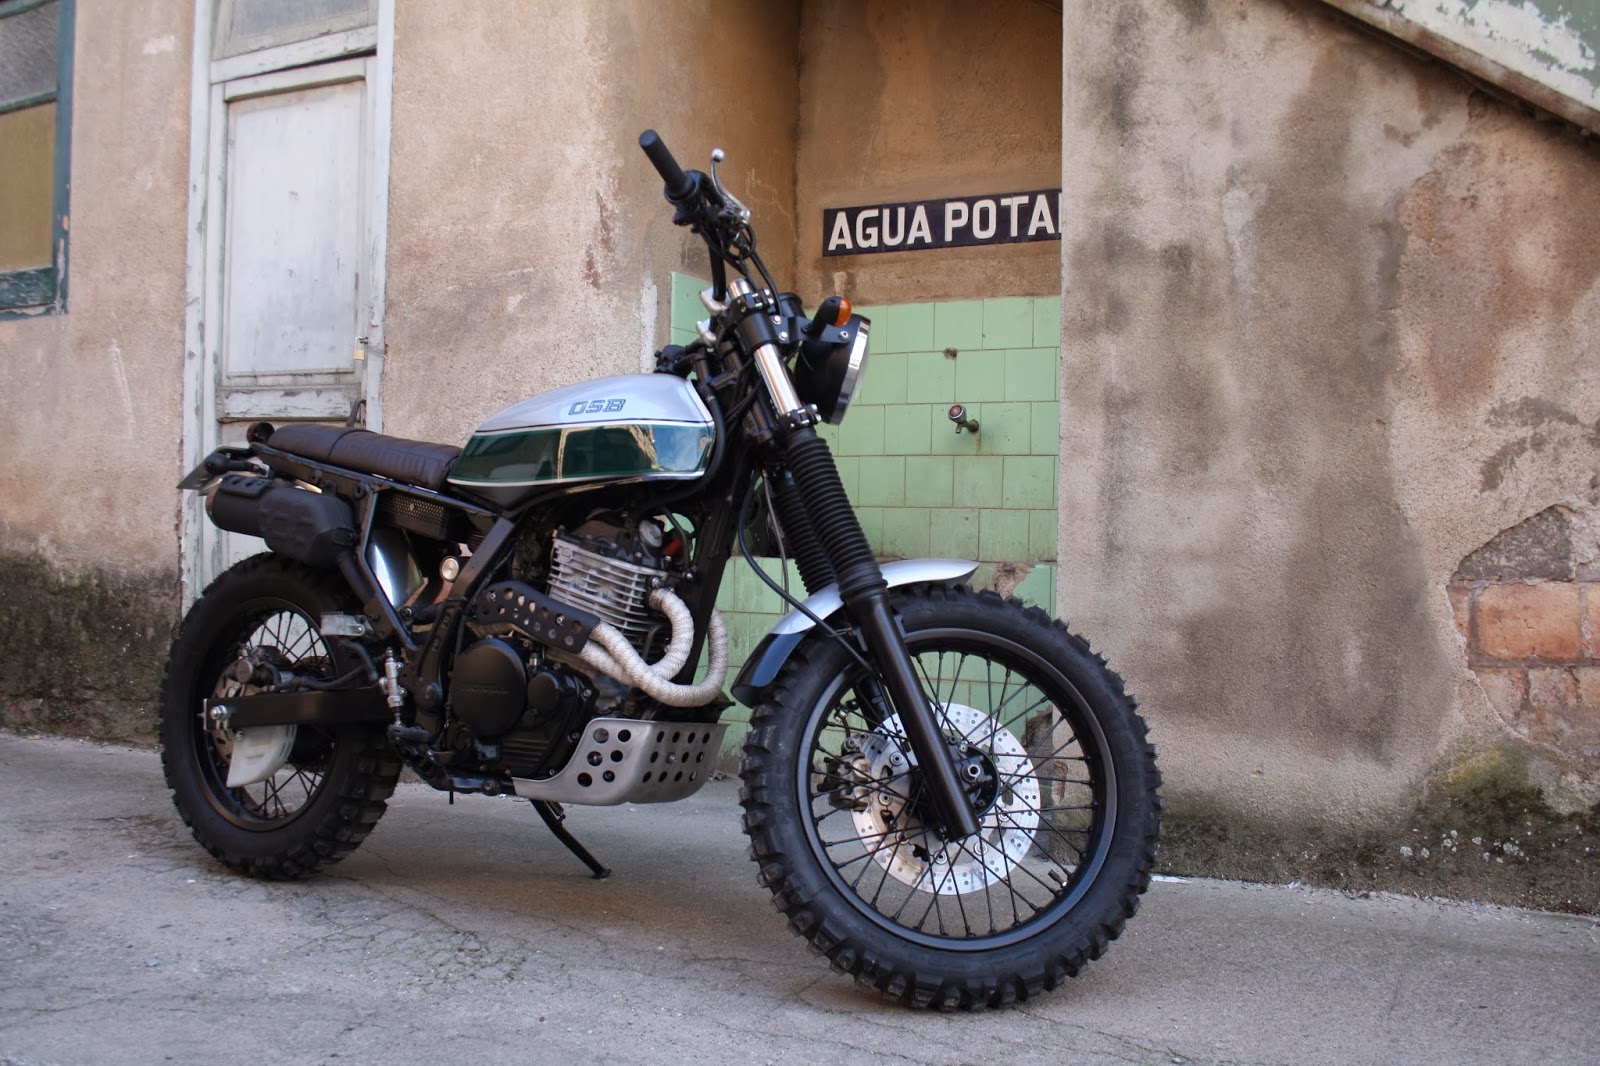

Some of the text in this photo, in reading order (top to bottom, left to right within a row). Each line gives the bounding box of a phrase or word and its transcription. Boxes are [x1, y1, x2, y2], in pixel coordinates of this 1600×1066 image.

[828, 193, 1062, 250] AGUA POTA
[568, 398, 626, 415] OSB
